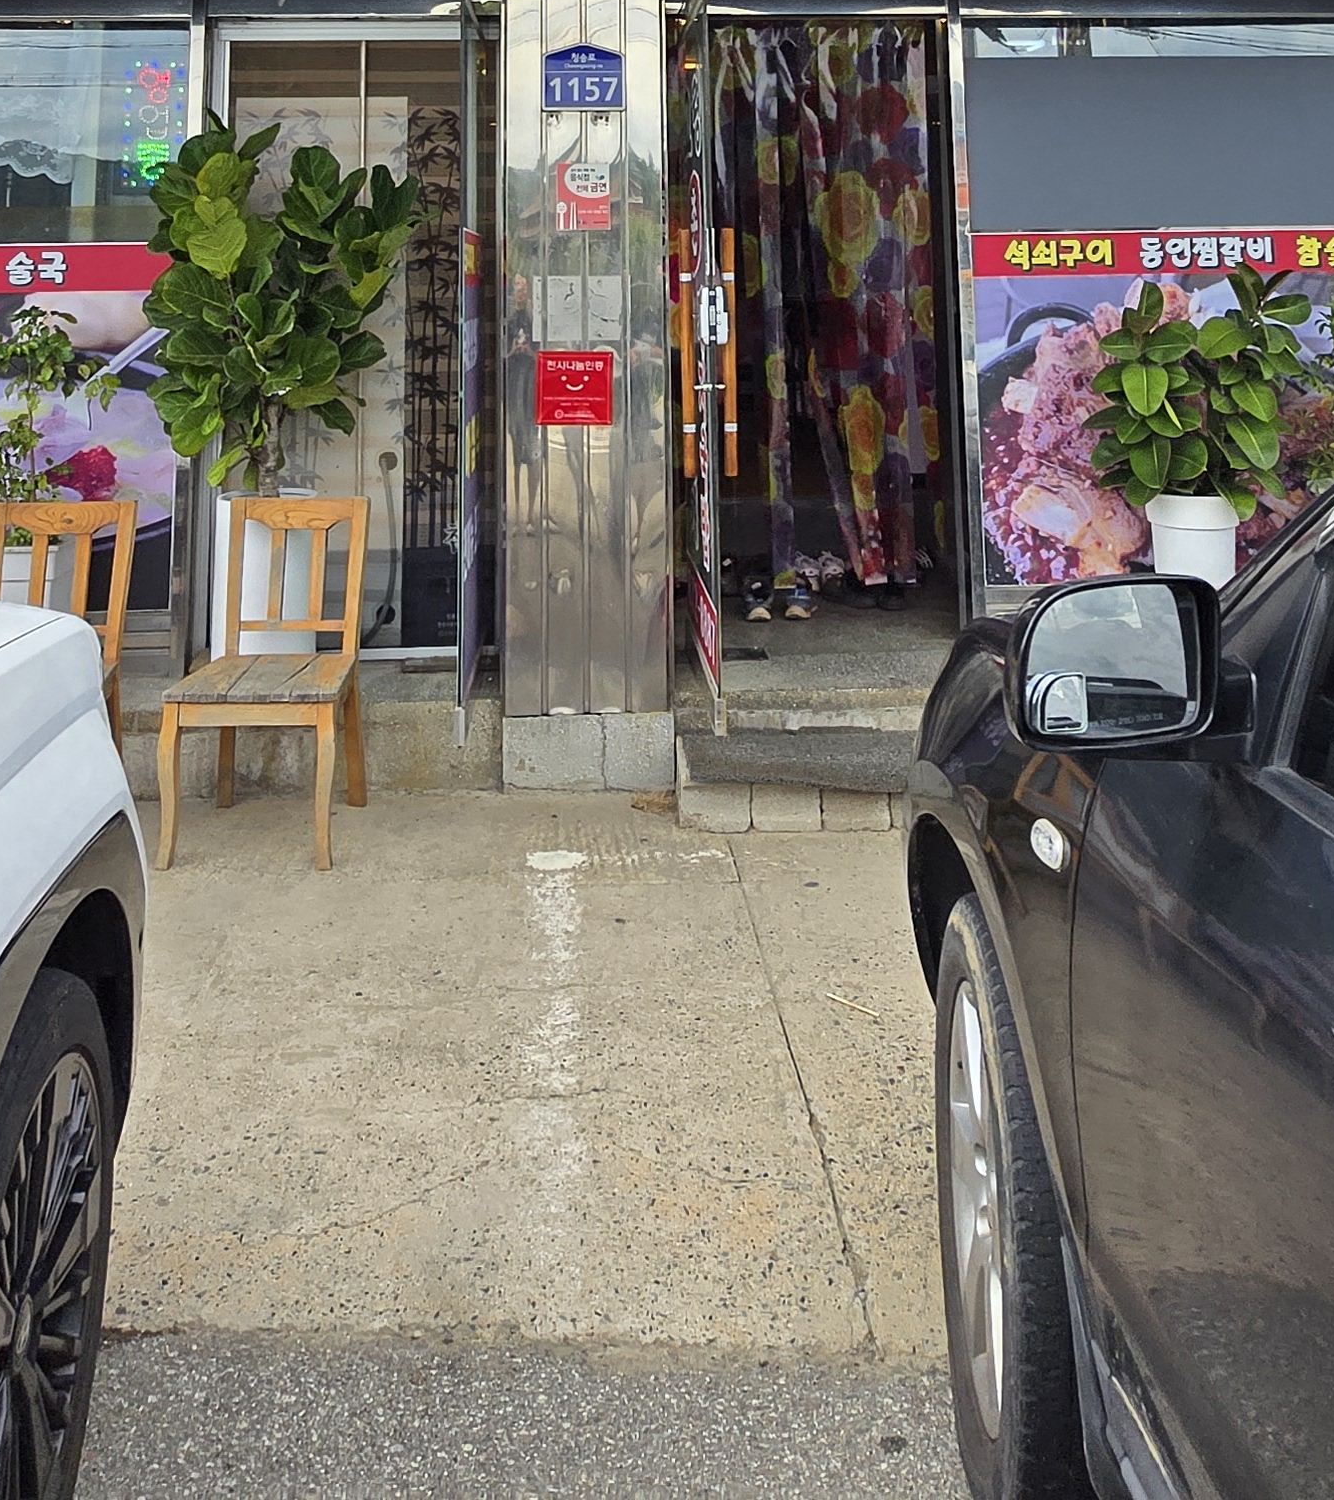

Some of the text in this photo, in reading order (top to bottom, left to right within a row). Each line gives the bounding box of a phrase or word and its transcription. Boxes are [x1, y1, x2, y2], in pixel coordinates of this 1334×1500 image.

[549, 77, 618, 101] 1157
[590, 183, 606, 192] 금연
[5, 251, 67, 284] 술국
[1004, 239, 1113, 271] 석쇠구이
